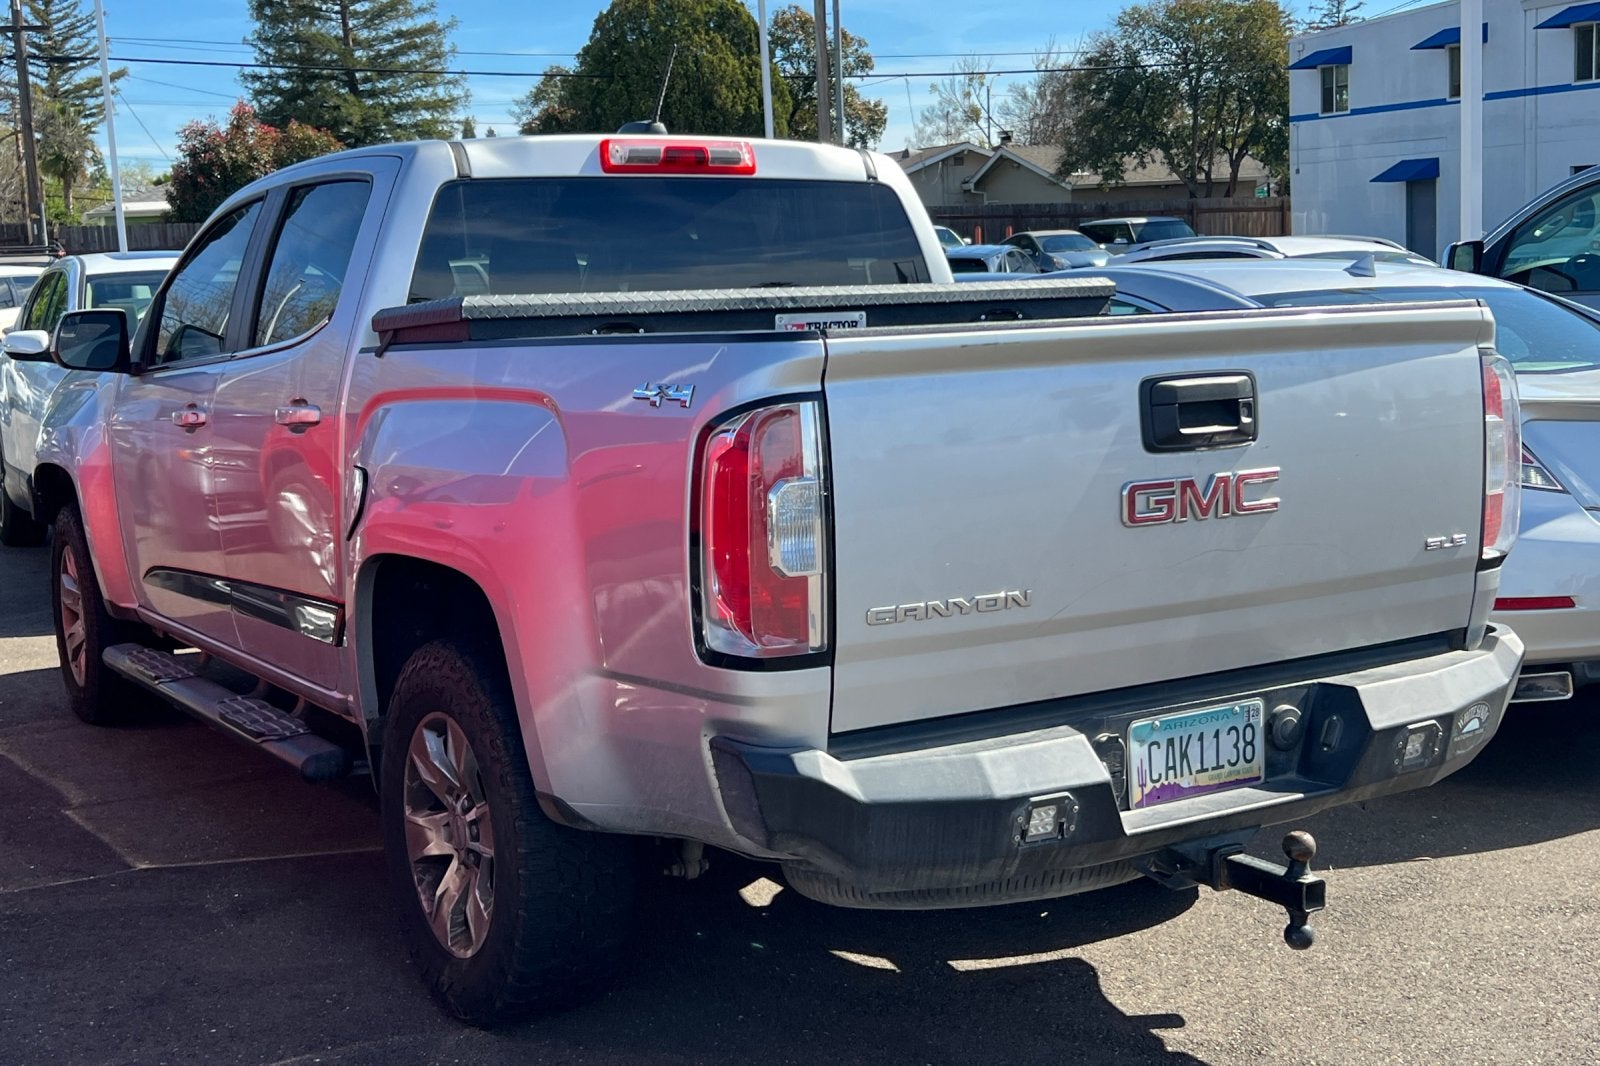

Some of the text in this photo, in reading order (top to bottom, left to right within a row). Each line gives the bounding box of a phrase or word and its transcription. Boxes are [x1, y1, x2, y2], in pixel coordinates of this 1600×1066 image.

[806, 320, 859, 331] TRACTOR
[1120, 466, 1281, 528] GMC
[866, 588, 1033, 626] CANYON
[1162, 713, 1230, 731] ARIZONA
[1148, 723, 1256, 784] CAK1138
